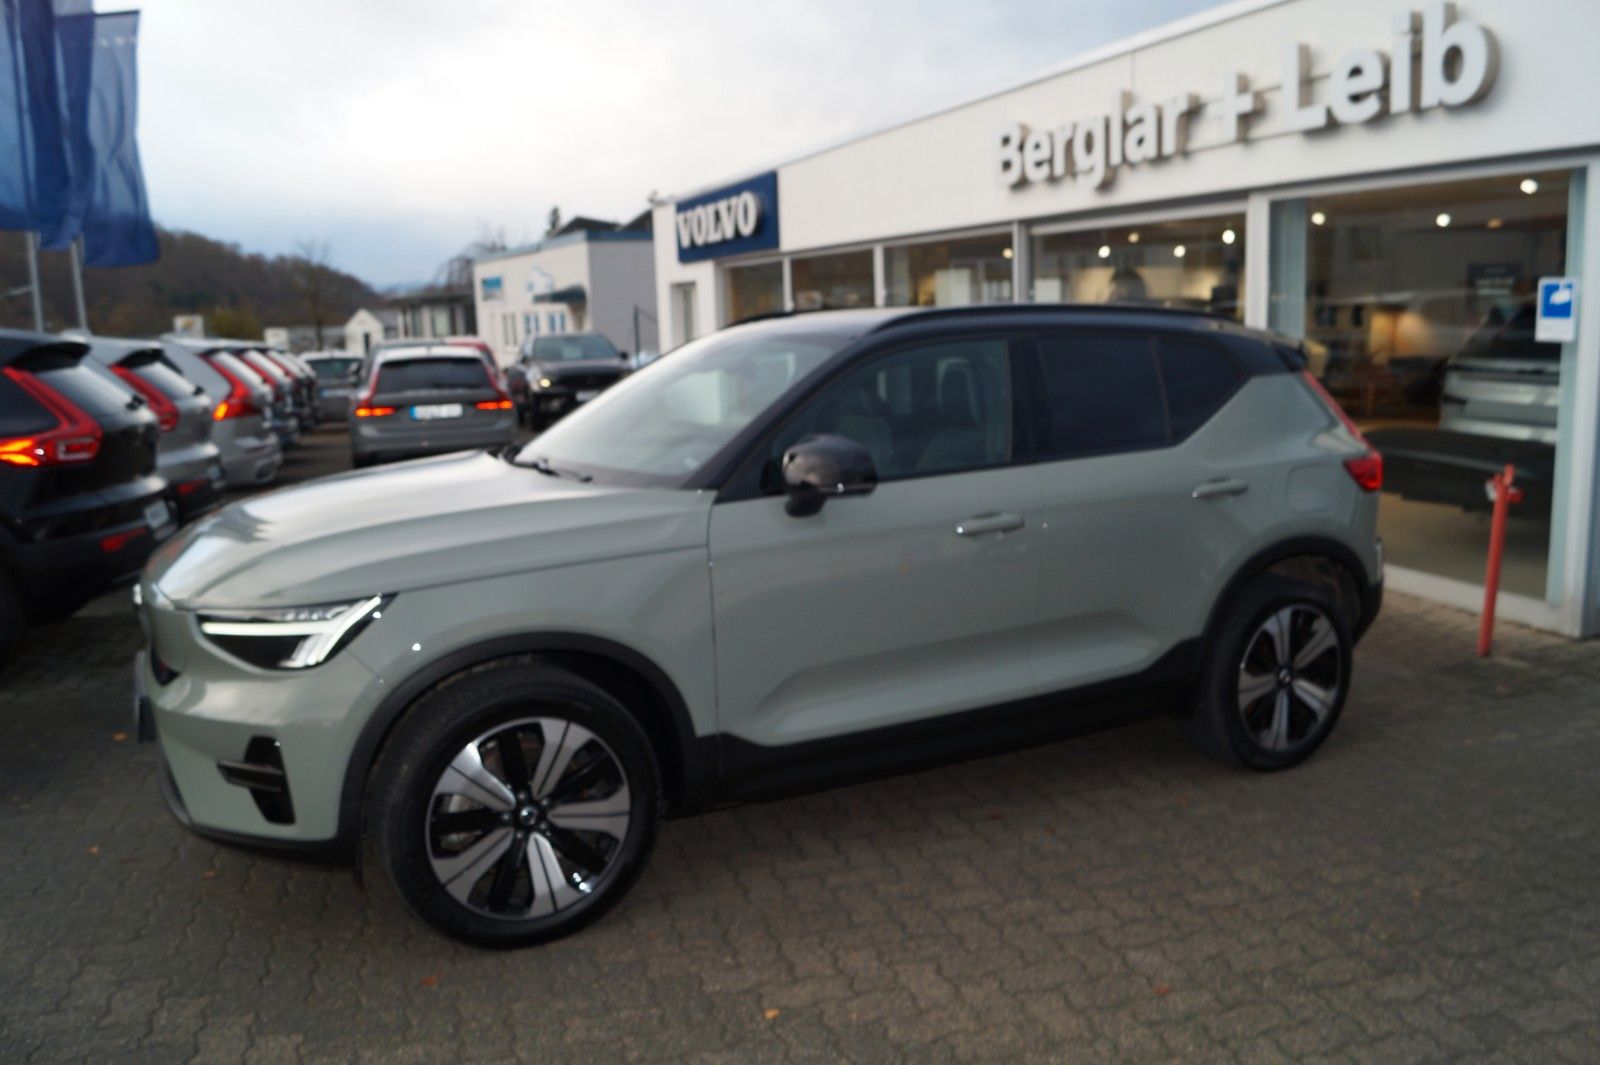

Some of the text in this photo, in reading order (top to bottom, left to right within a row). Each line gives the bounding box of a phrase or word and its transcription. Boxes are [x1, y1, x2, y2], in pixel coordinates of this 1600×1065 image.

[996, 1, 1495, 191] Berglar + Leib
[676, 191, 758, 248] VOLVO
